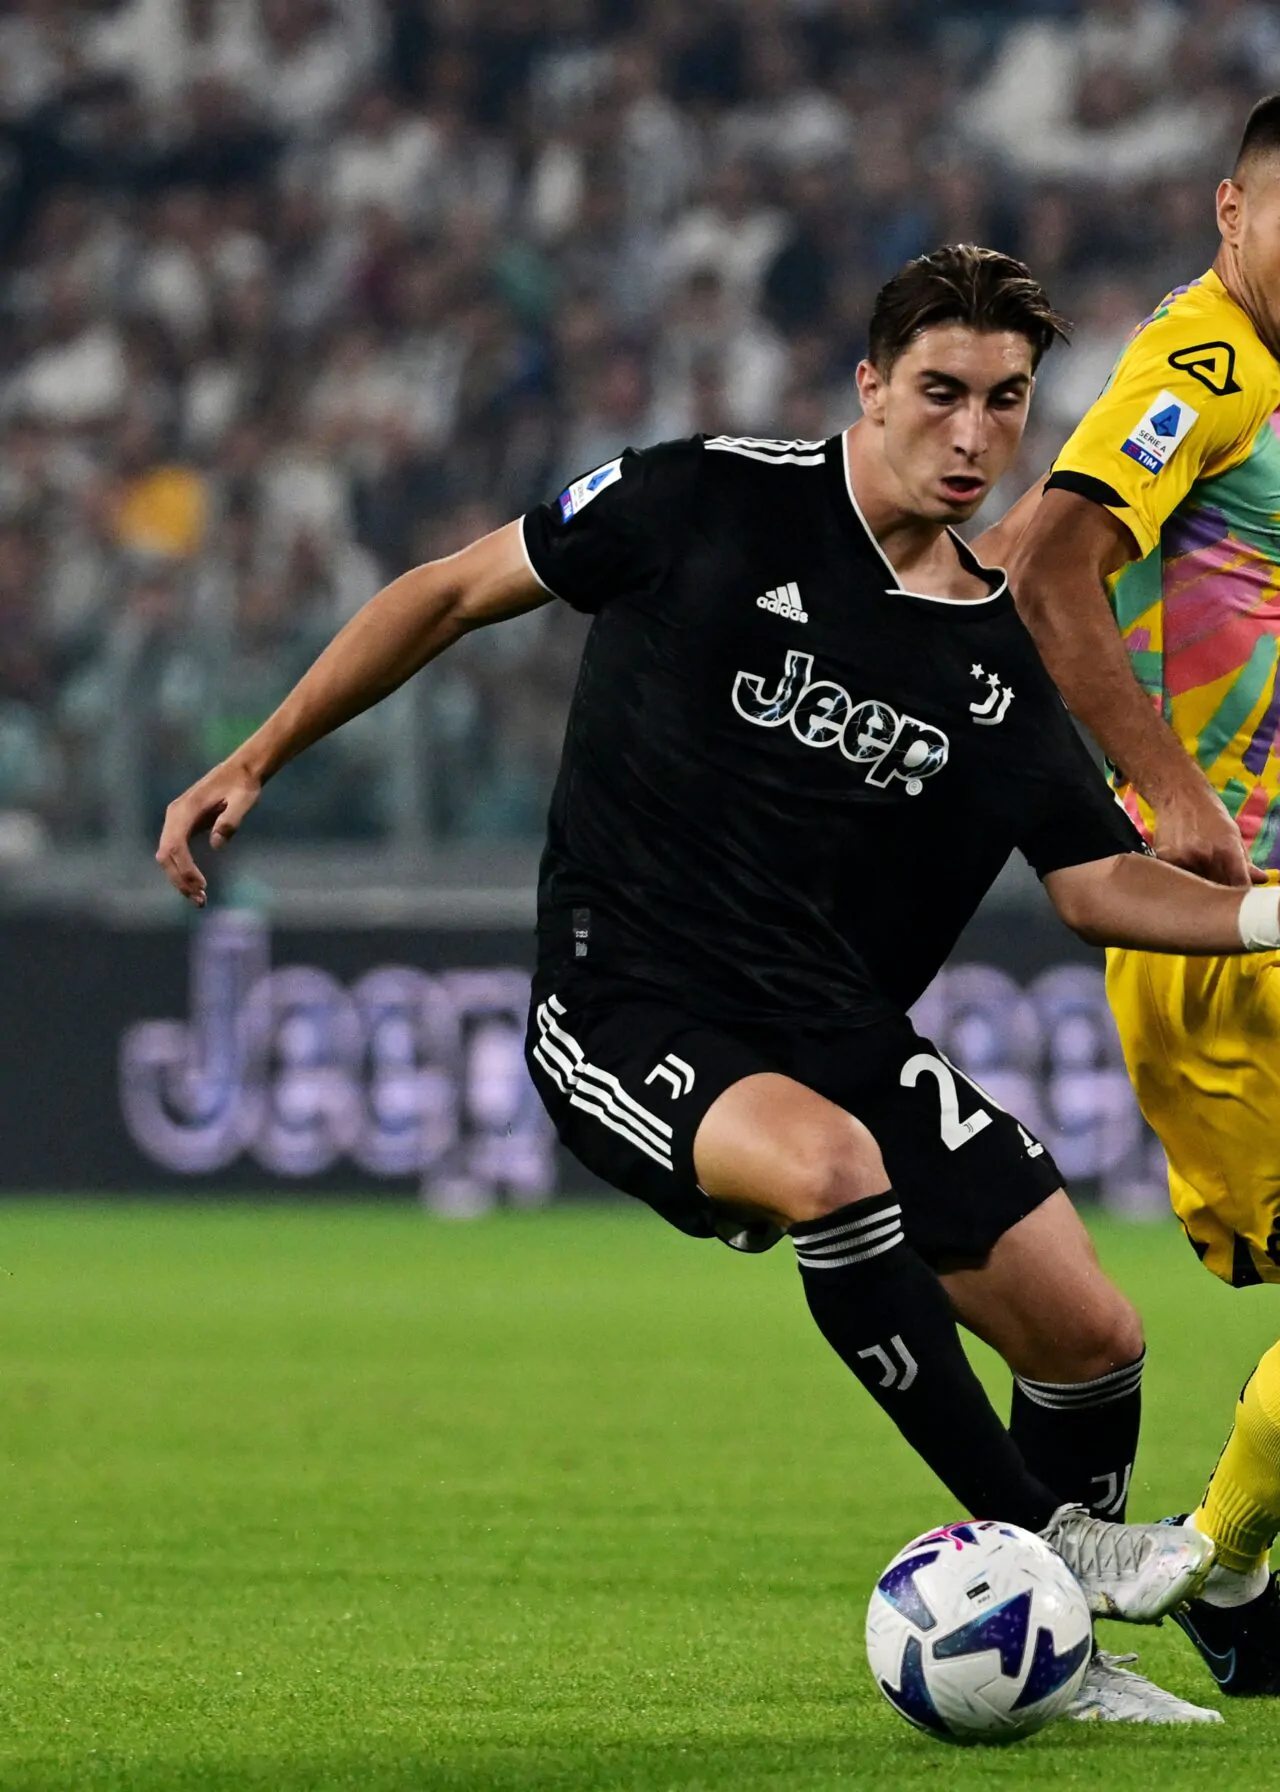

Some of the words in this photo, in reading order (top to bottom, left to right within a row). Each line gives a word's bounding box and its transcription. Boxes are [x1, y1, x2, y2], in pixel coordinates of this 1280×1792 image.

[1139, 430, 1162, 448] SERIE
[1137, 451, 1158, 469] TIM
[756, 596, 808, 623] adidas
[732, 650, 949, 789] Jeep
[118, 905, 558, 1220] Jeep
